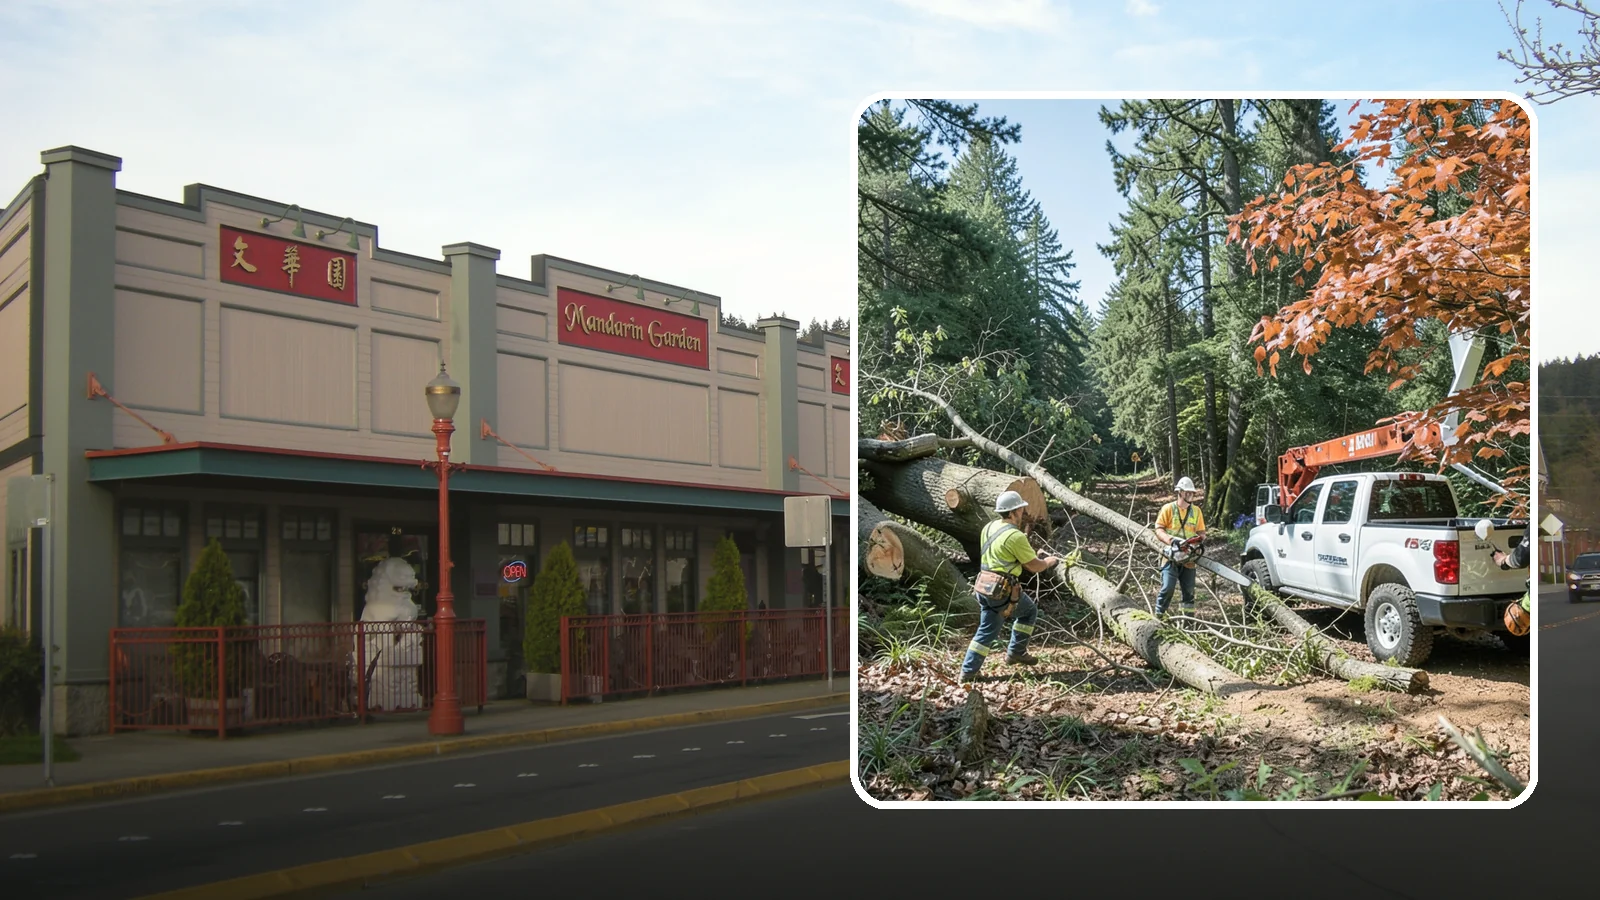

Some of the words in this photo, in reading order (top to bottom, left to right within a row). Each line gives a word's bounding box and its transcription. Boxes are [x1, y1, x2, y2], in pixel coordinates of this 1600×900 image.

[231, 236, 346, 291] 文華園
[564, 302, 644, 341] Mandarin
[648, 320, 702, 352] Garden
[503, 565, 527, 578] OPEN
